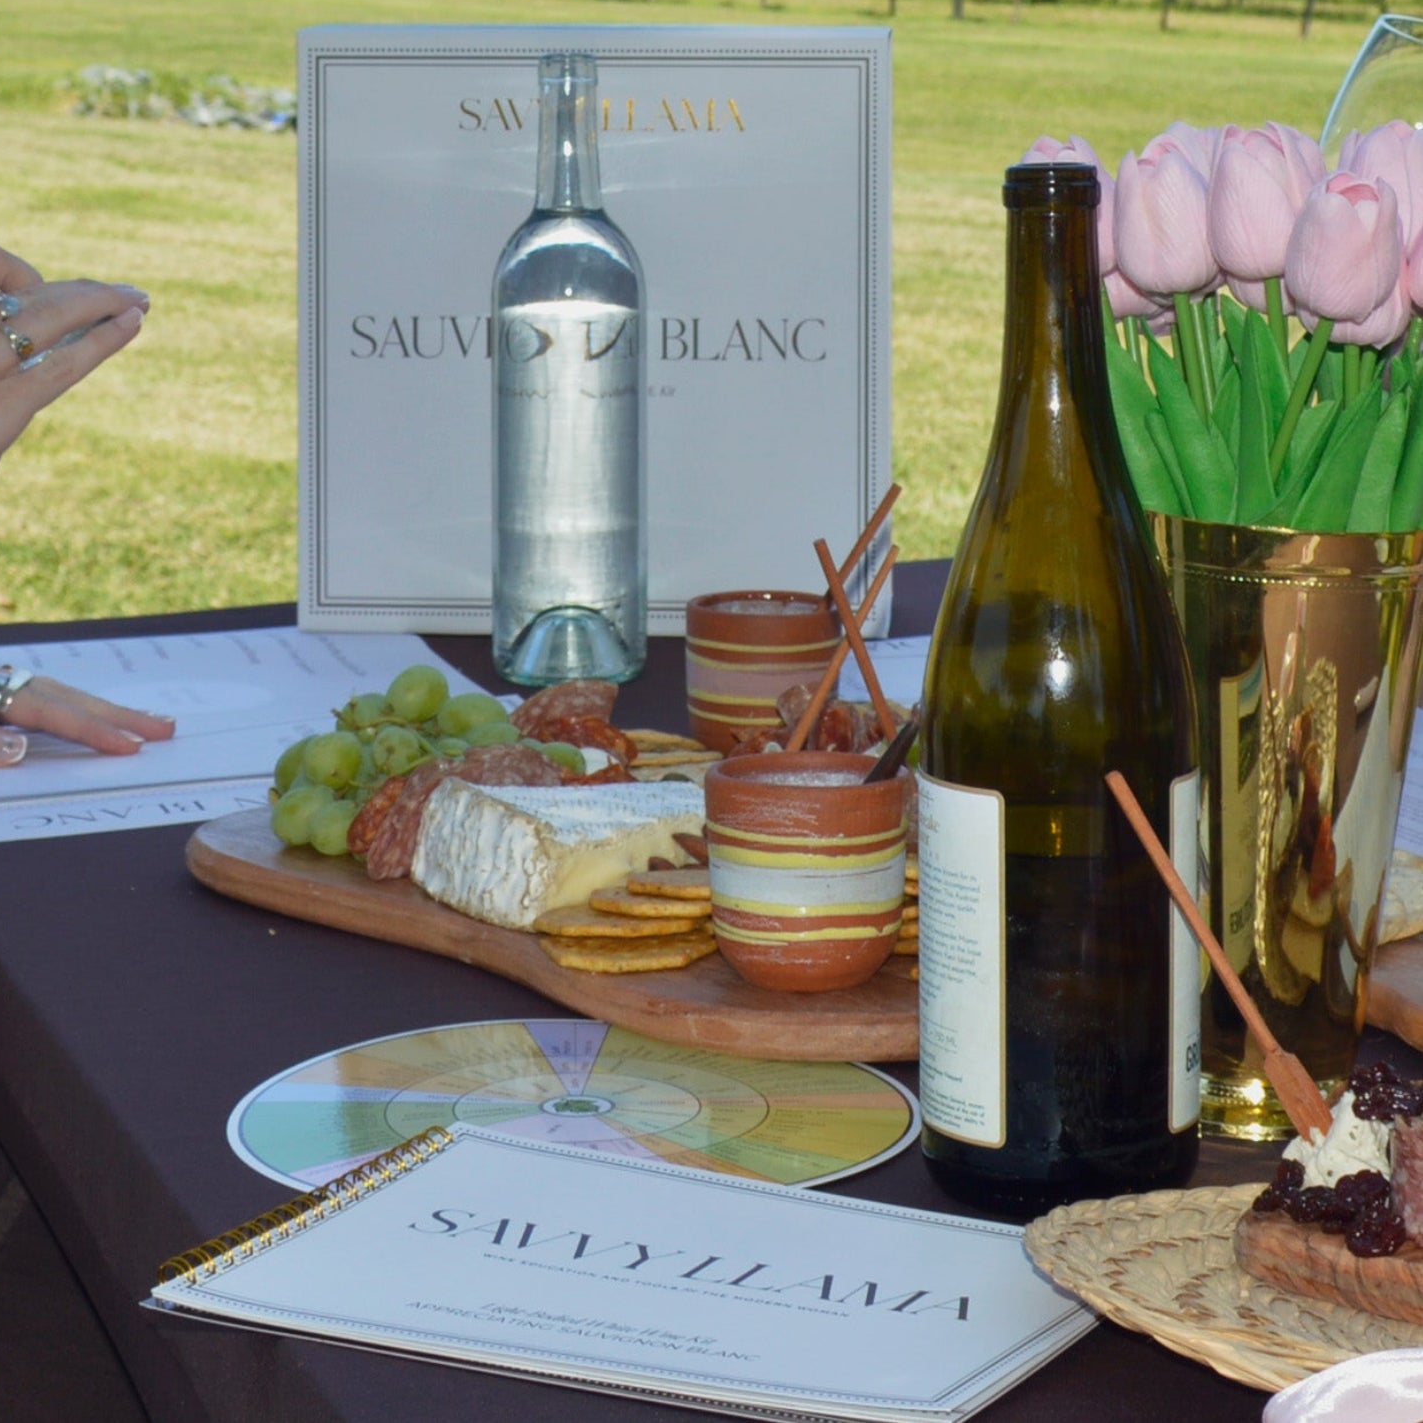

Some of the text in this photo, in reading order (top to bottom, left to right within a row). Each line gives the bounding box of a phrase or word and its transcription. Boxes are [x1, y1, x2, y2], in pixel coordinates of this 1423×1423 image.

[601, 97, 746, 132] LLAMA
[660, 317, 828, 362] BLANC
[407, 1208, 969, 1321] SAVVY LLAMA
[405, 1301, 762, 1362] APPRECIATING SAUVIGNON BLANC
